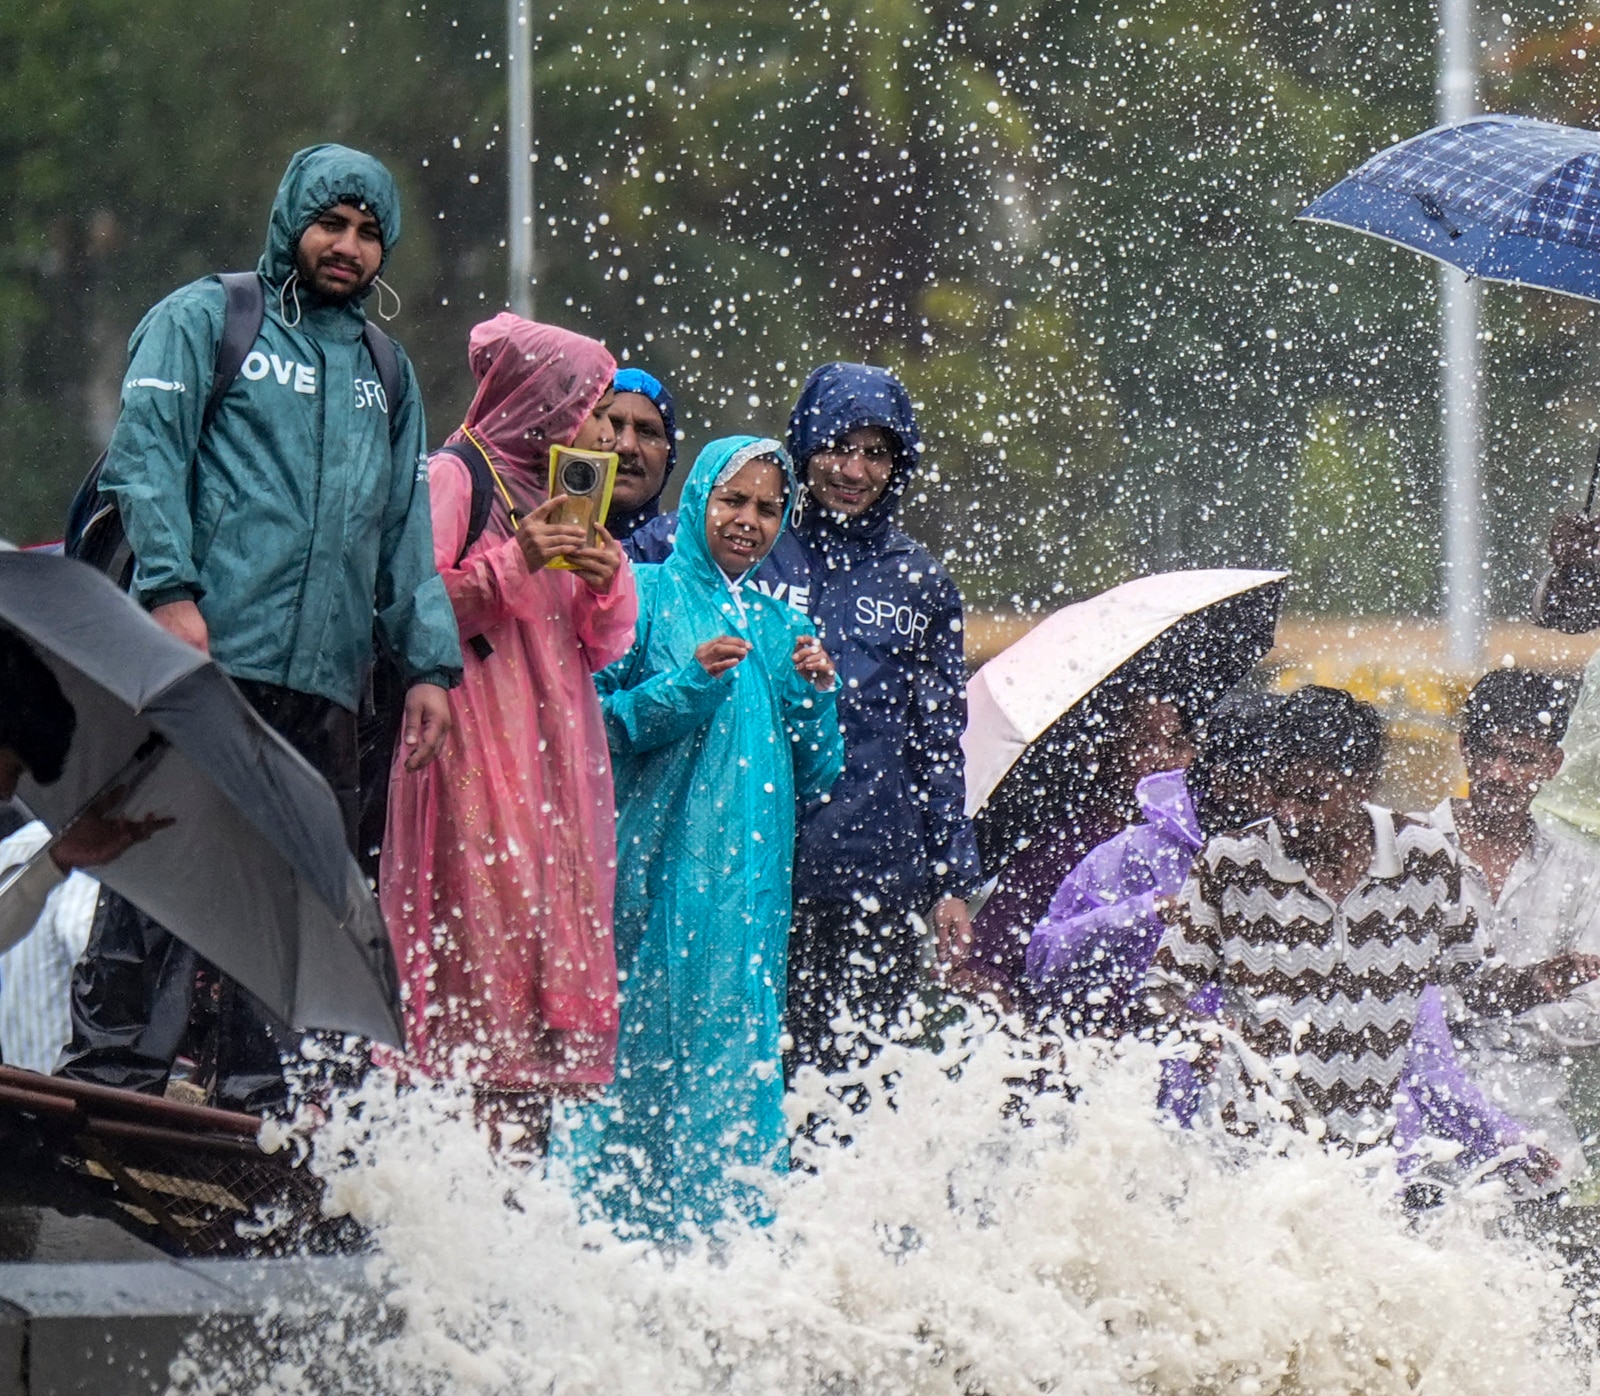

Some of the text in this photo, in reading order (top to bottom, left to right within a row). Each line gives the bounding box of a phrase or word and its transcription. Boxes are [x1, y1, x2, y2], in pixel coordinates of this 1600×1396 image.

[235, 351, 316, 394] OVE
[744, 579, 929, 642] VE SPOR
